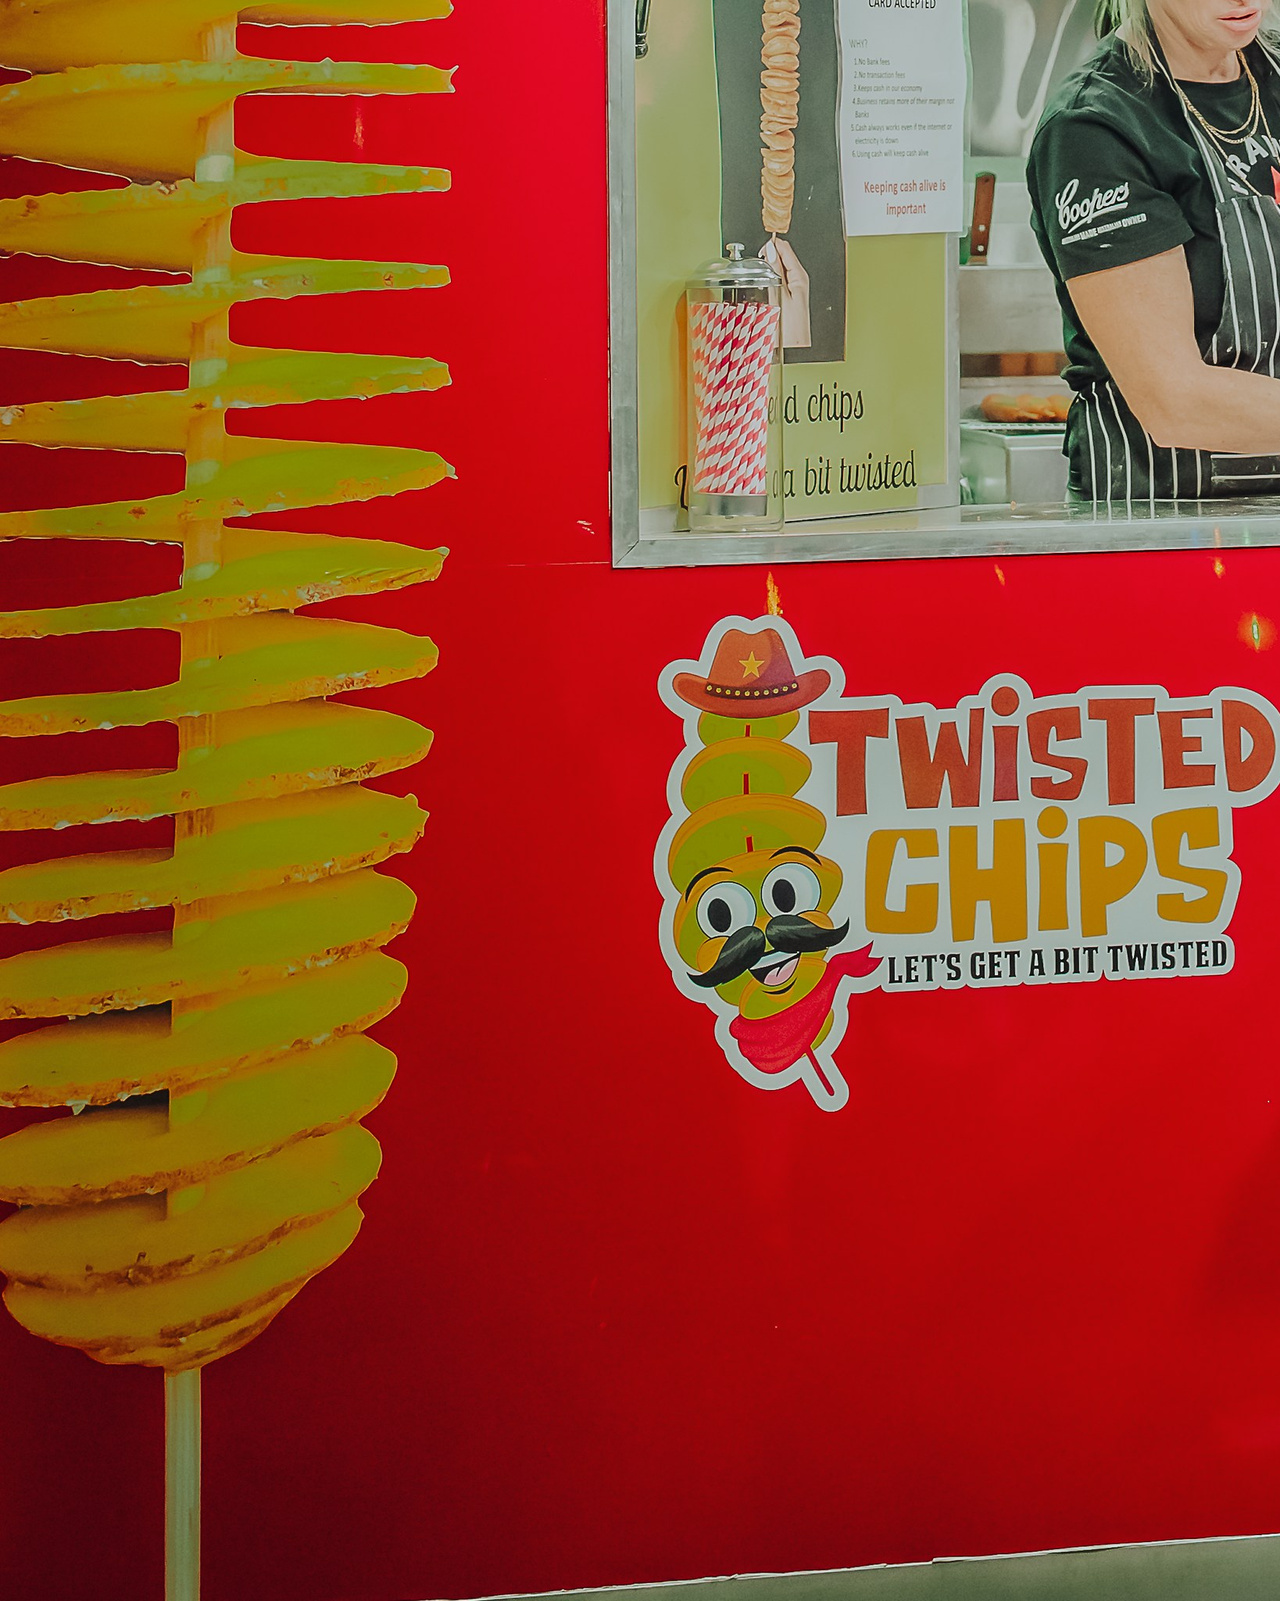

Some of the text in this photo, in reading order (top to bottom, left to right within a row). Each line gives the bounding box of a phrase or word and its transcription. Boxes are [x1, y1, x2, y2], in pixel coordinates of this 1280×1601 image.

[864, 179, 946, 195] Keeping cash alive is
[1055, 179, 1130, 230] Coopers
[886, 203, 927, 217] important
[807, 381, 864, 434] chips
[804, 456, 832, 496] bit
[839, 450, 917, 494] twisted
[887, 940, 1228, 985] LET'S GET A BIT TWISTED
